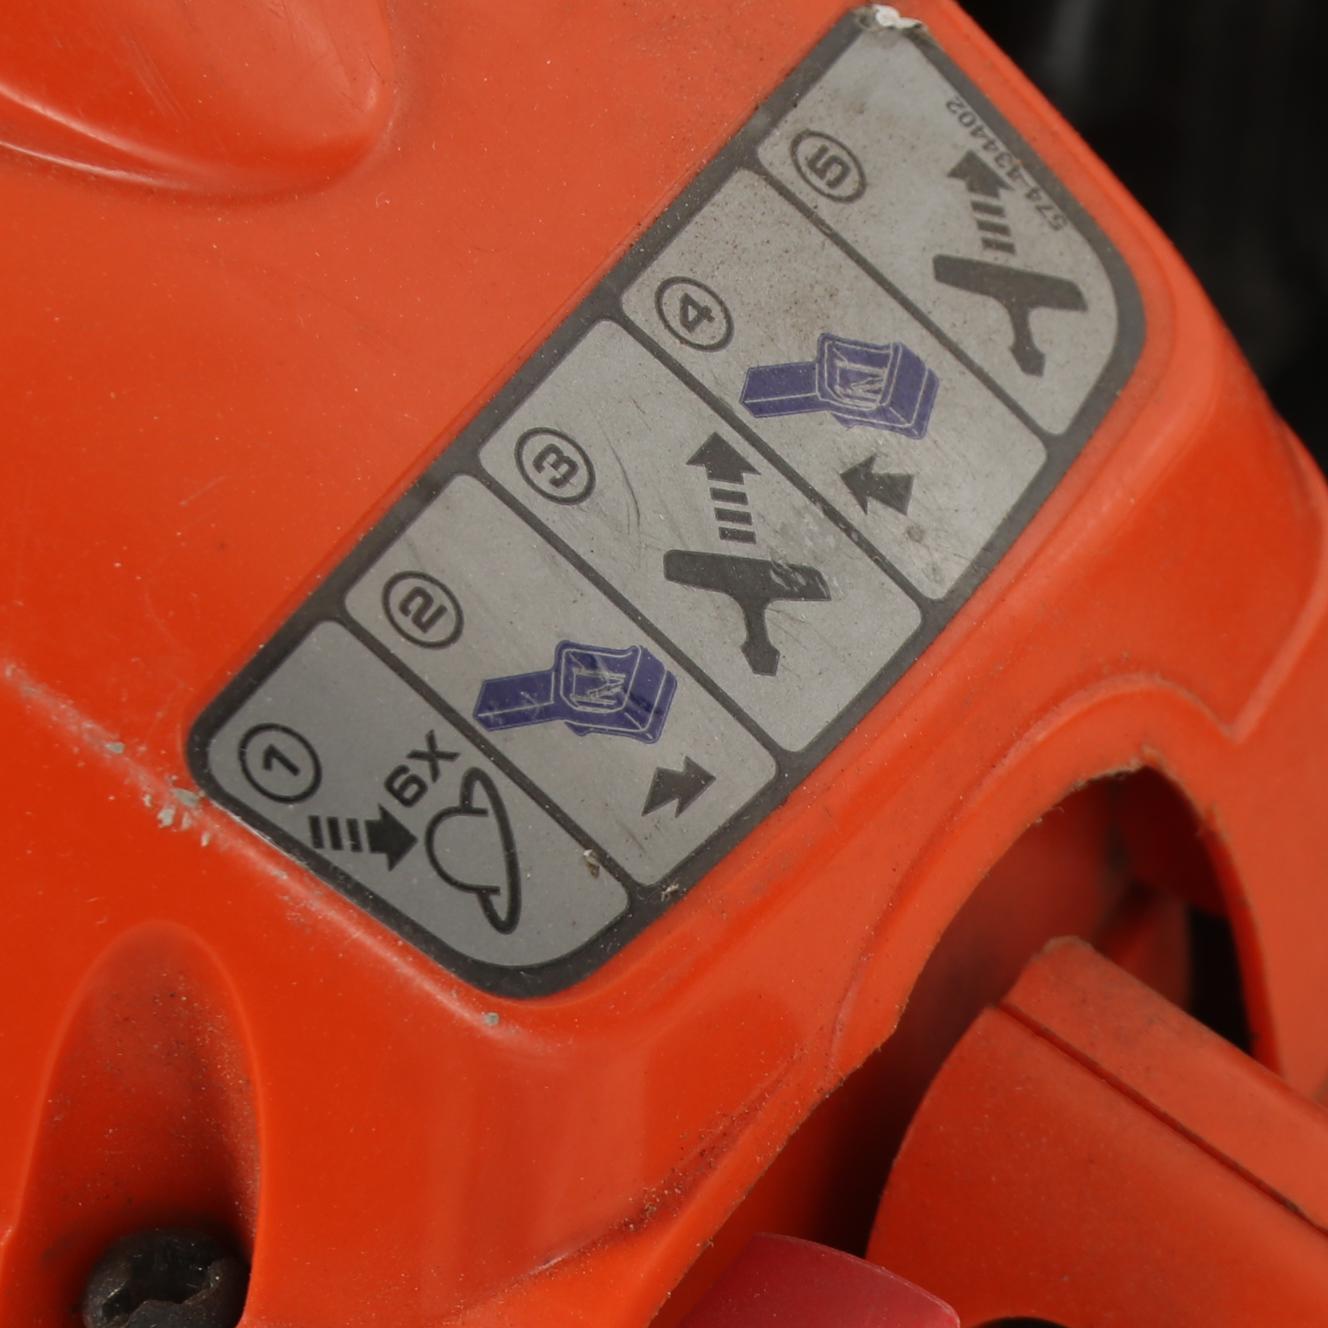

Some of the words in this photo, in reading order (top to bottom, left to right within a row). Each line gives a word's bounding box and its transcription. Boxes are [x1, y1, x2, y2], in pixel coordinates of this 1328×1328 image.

[806, 143, 852, 190] 5
[678, 292, 716, 334] 4
[532, 443, 580, 490] 3
[398, 585, 448, 635] 2
[383, 730, 461, 808] 6X
